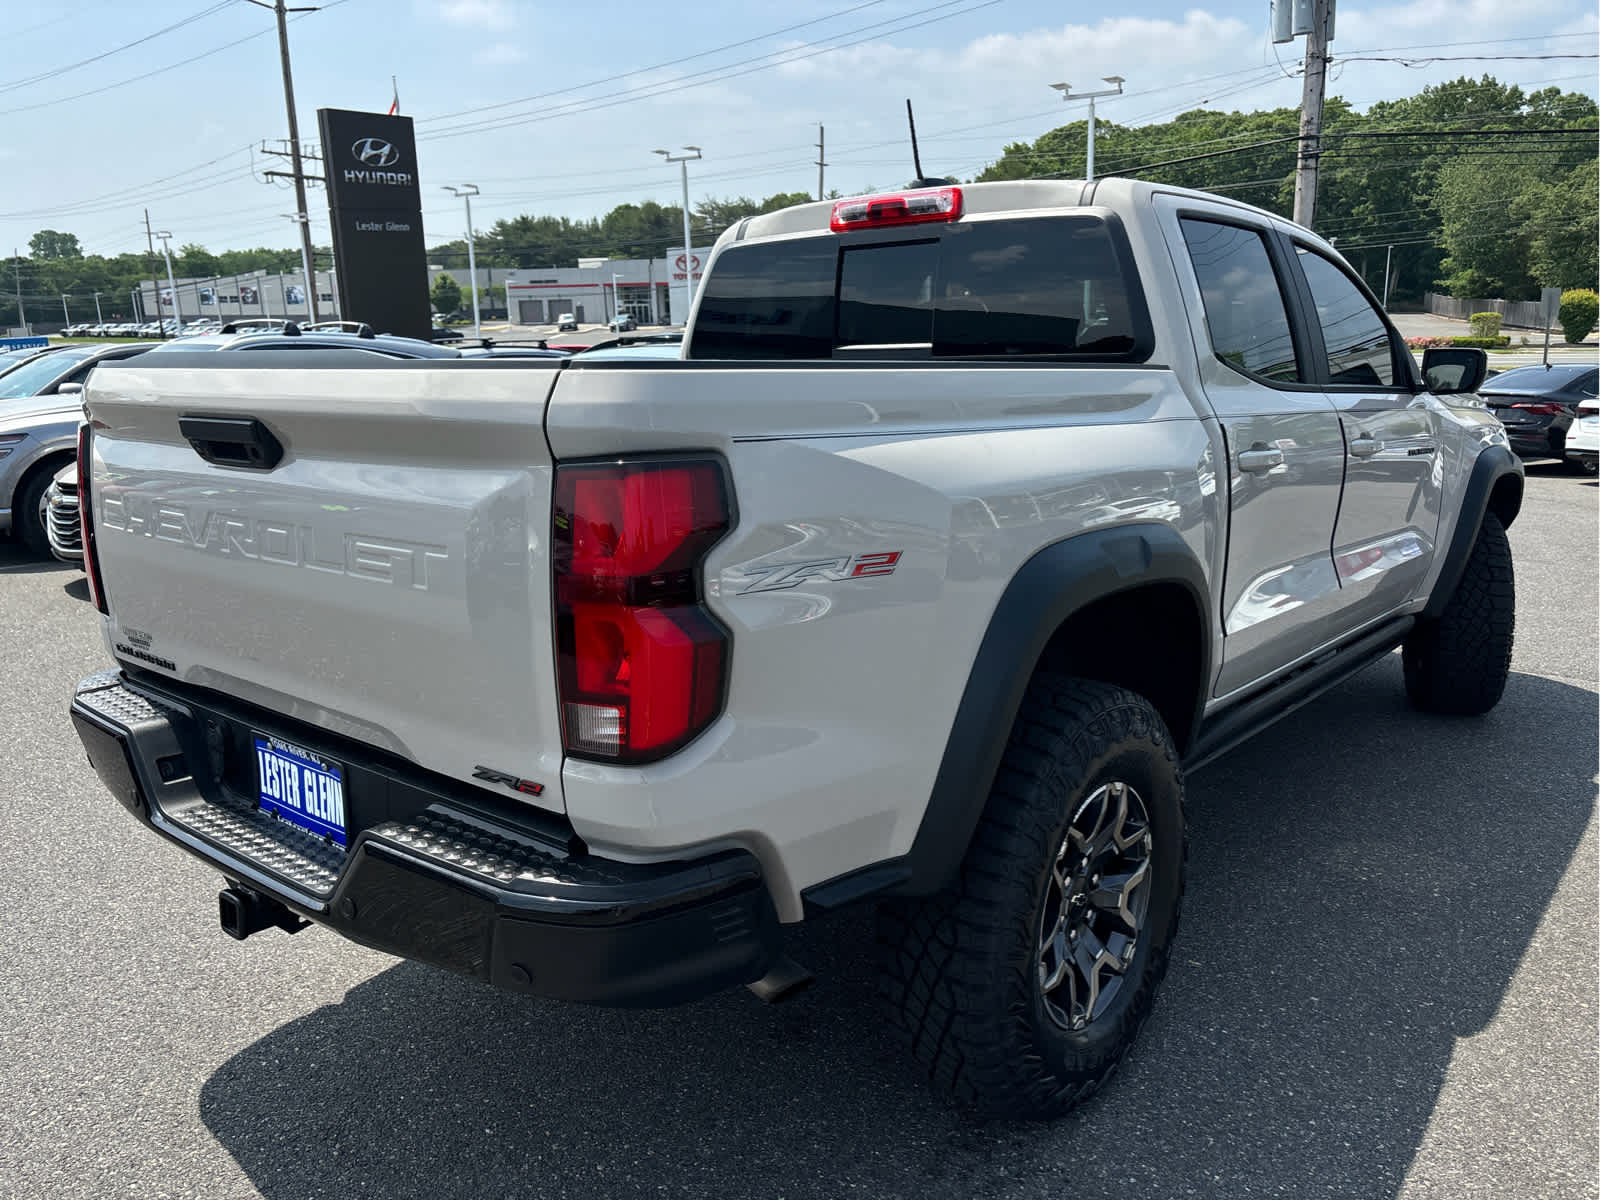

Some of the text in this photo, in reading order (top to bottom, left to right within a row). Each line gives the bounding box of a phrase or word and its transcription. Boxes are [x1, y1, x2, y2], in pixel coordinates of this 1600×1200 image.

[344, 169, 412, 186] HYUNDAI
[355, 221, 410, 232] Lester Glenn
[100, 484, 449, 591] CHEVROLET
[735, 550, 904, 595] ZR2
[257, 750, 345, 828] LESTER GLENN
[471, 765, 545, 797] ZR2
